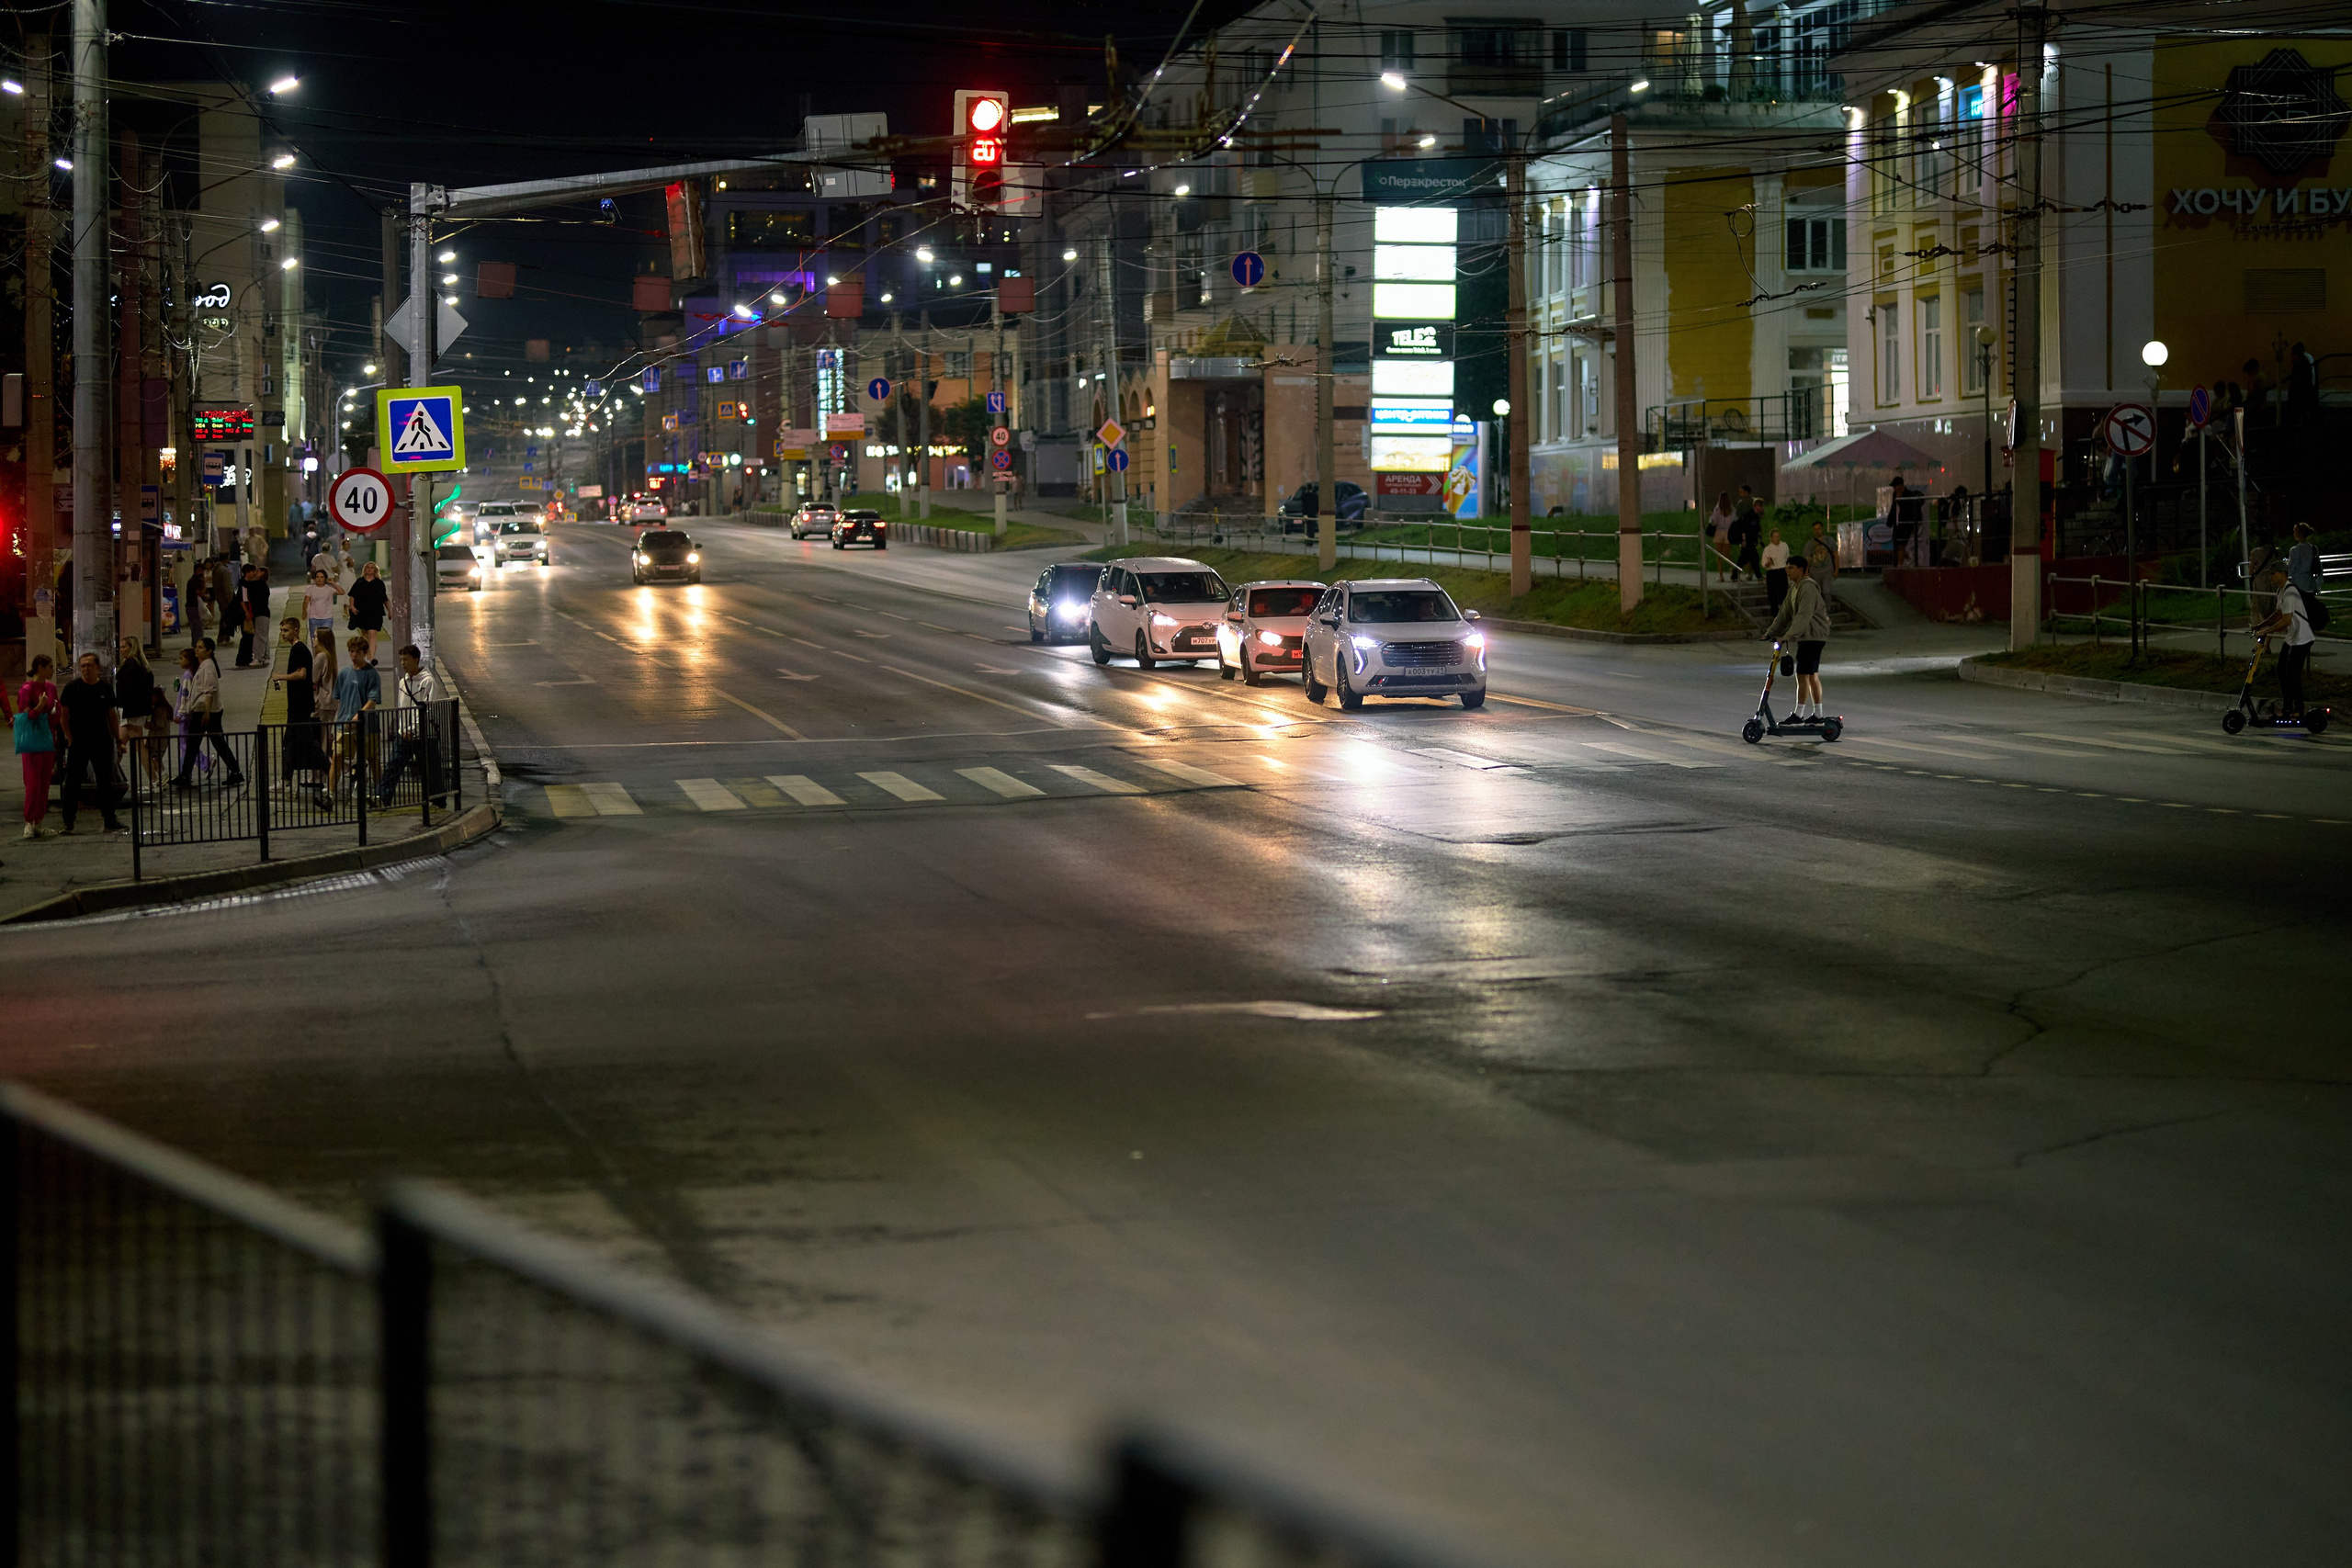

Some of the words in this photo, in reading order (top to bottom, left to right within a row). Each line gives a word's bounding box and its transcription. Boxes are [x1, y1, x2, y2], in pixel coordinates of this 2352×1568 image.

[2172, 187, 2267, 214] ХОЧУ
[2277, 187, 2299, 214] И
[2310, 187, 2352, 214] БУ
[1392, 326, 1437, 346] TELE2
[996, 432, 1006, 441] 40
[1385, 476, 1421, 484] АРЕНДА
[345, 487, 378, 513] 40
